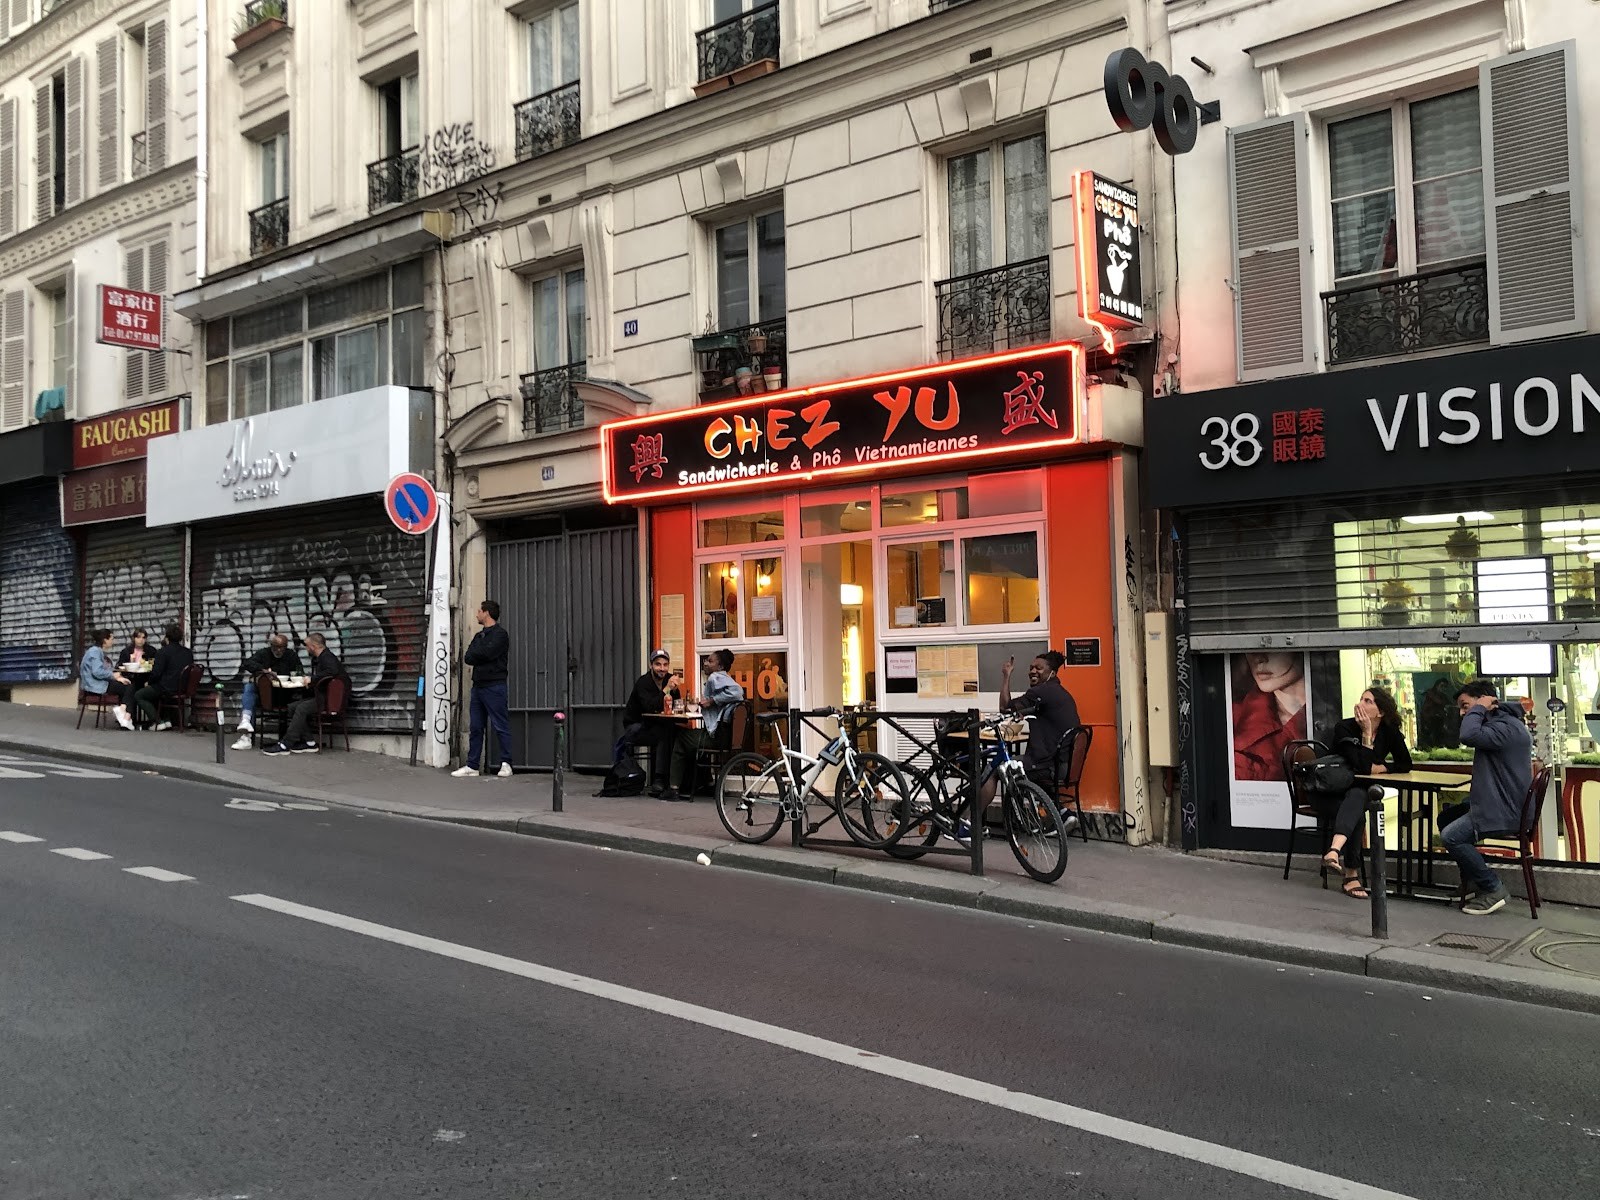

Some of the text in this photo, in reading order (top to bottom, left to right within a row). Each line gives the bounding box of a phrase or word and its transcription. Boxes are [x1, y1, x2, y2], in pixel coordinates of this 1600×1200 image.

[1094, 180, 1137, 208] SANDWICHERIE
[1095, 195, 1139, 228] CHEZ YU
[108, 291, 156, 312] 富家仕
[116, 310, 148, 329] 酒行
[625, 321, 637, 335] 40
[704, 381, 960, 459] CHEZ YU
[1001, 371, 1058, 435] 盛
[82, 407, 170, 448] FAUGASHI
[1199, 413, 1262, 470] 38
[542, 467, 554, 480] 40
[629, 433, 668, 483] 興
[678, 434, 978, 486] Sandwicherie & Phô Vietnamiennes
